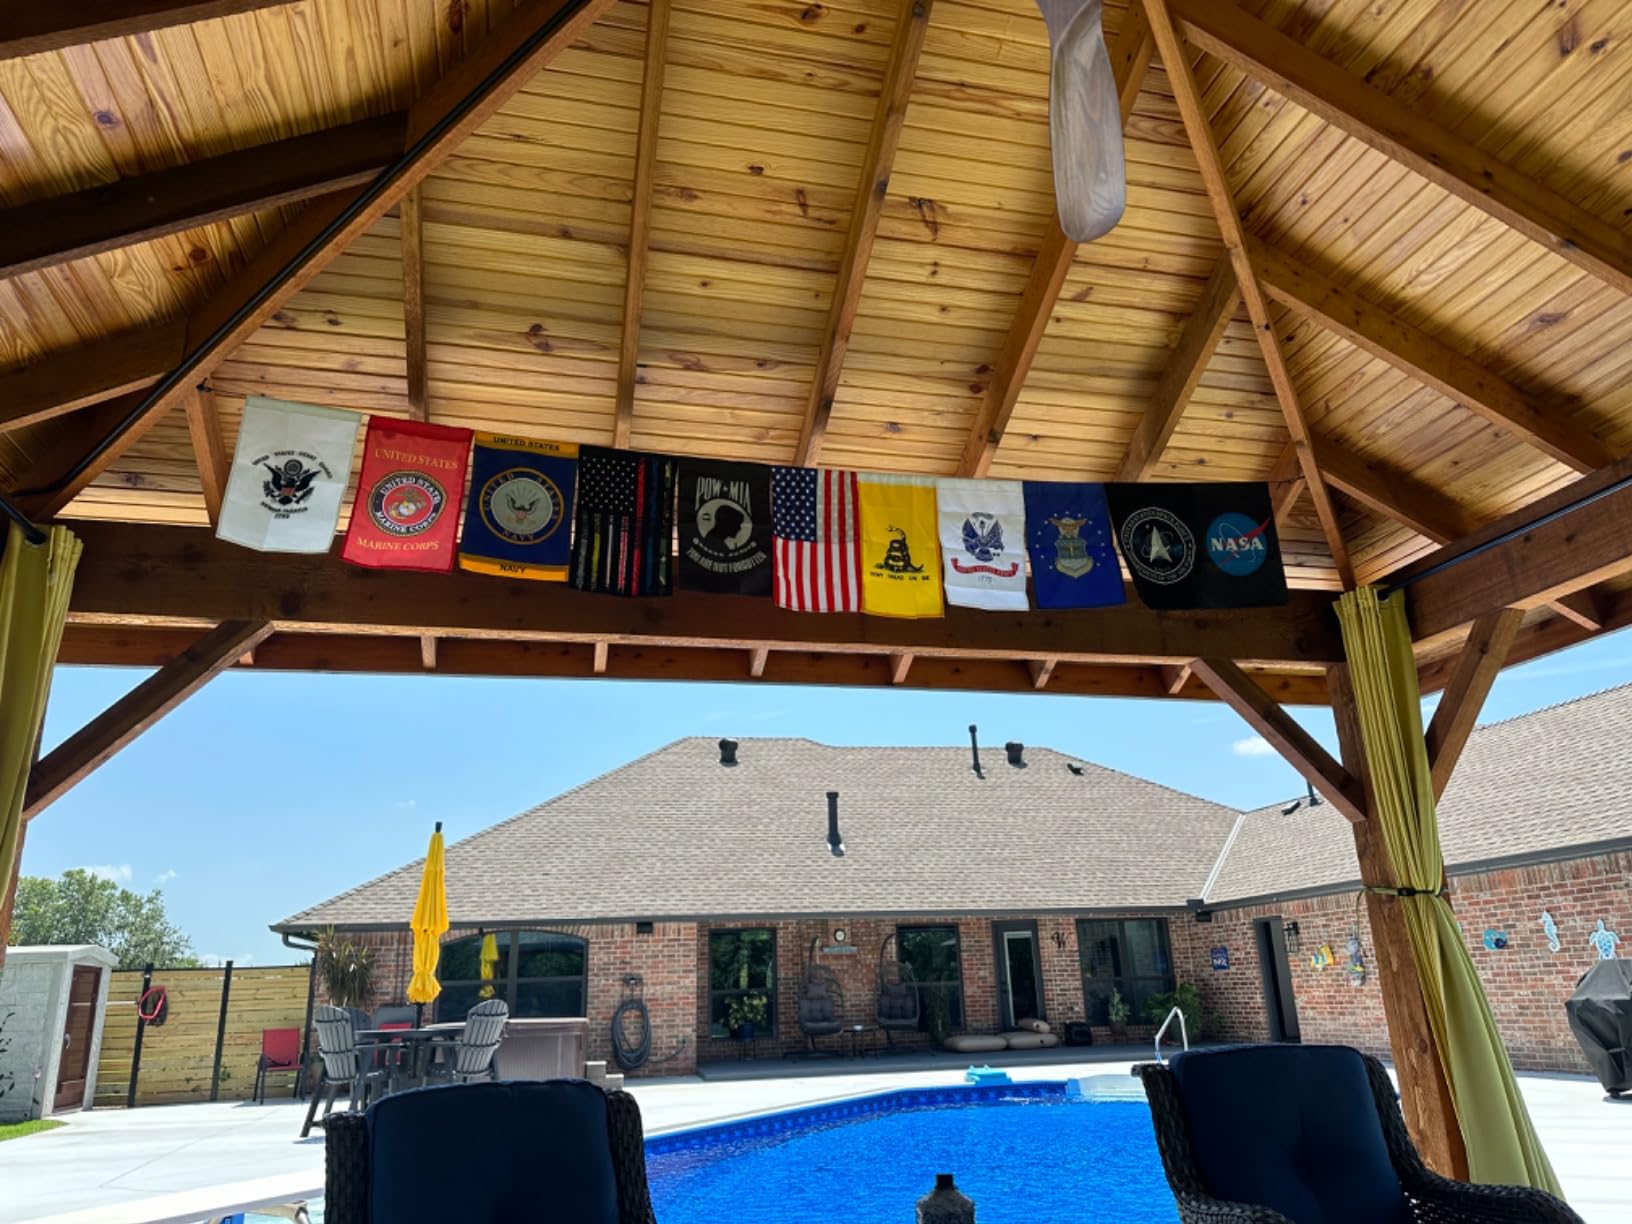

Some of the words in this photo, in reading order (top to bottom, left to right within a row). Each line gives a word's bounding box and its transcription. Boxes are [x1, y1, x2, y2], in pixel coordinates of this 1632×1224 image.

[494, 436, 526, 447] UNITED
[528, 441, 560, 452] STATES
[375, 448, 416, 463] UNITED
[418, 454, 458, 469] STATES
[695, 476, 722, 512] POW
[729, 480, 753, 517] MIA
[356, 536, 402, 551] MARINE
[403, 540, 440, 551] CORPS
[1211, 536, 1265, 552] NASA
[500, 564, 527, 575] NAVY
